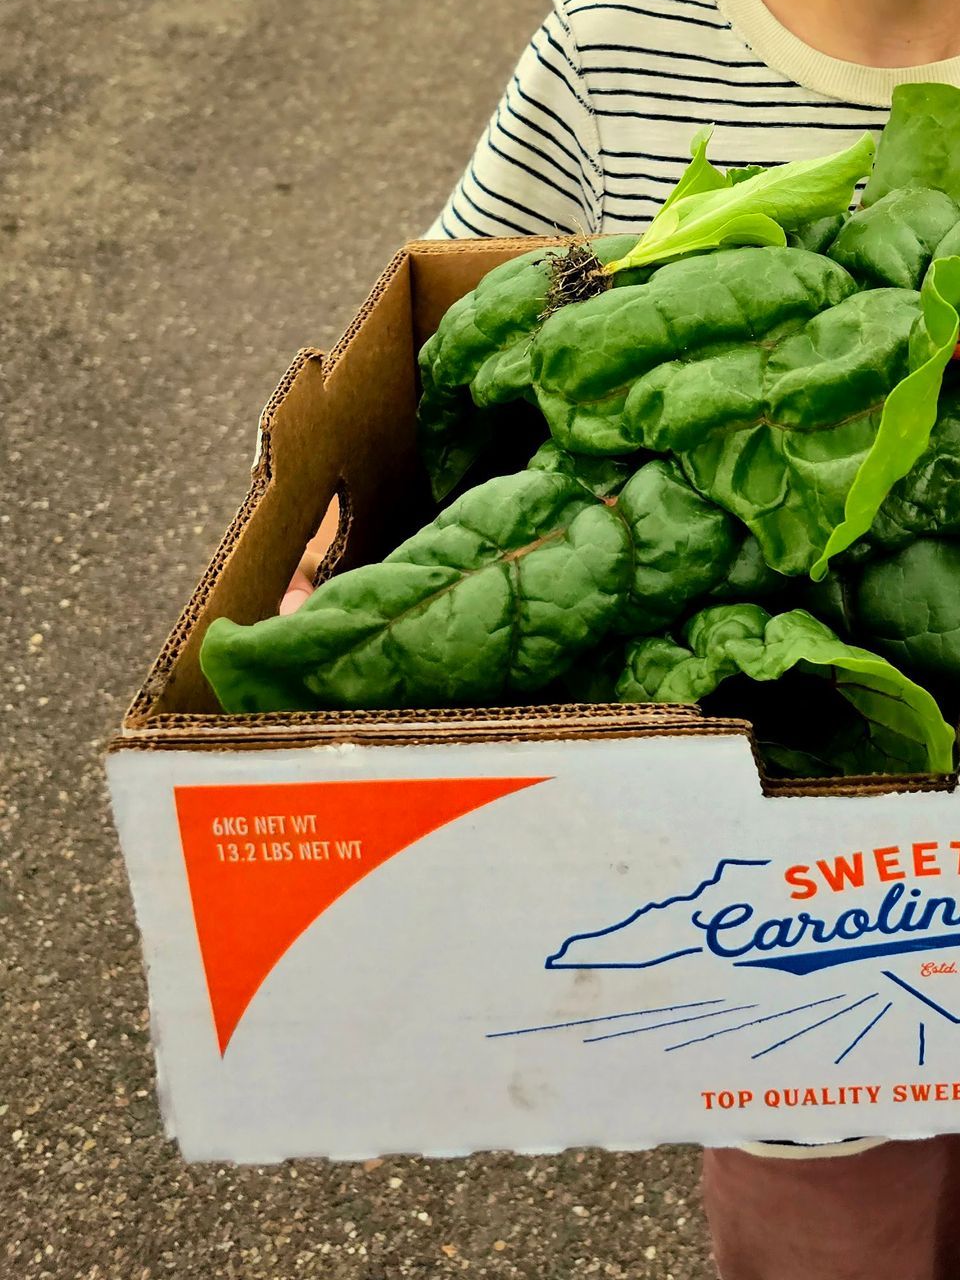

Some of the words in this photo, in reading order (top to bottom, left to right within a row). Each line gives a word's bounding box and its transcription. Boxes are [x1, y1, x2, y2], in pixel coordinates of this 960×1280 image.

[212, 816, 249, 836] 6KG
[254, 815, 286, 835] NET
[290, 814, 317, 835] WT
[216, 842, 257, 862] 13.2
[262, 841, 294, 861] LBS
[298, 841, 330, 861] NET
[335, 840, 363, 860] WT
[920, 961, 958, 977] Estd.
[701, 1090, 754, 1110] TOP
[764, 1085, 882, 1108] QUALITY
